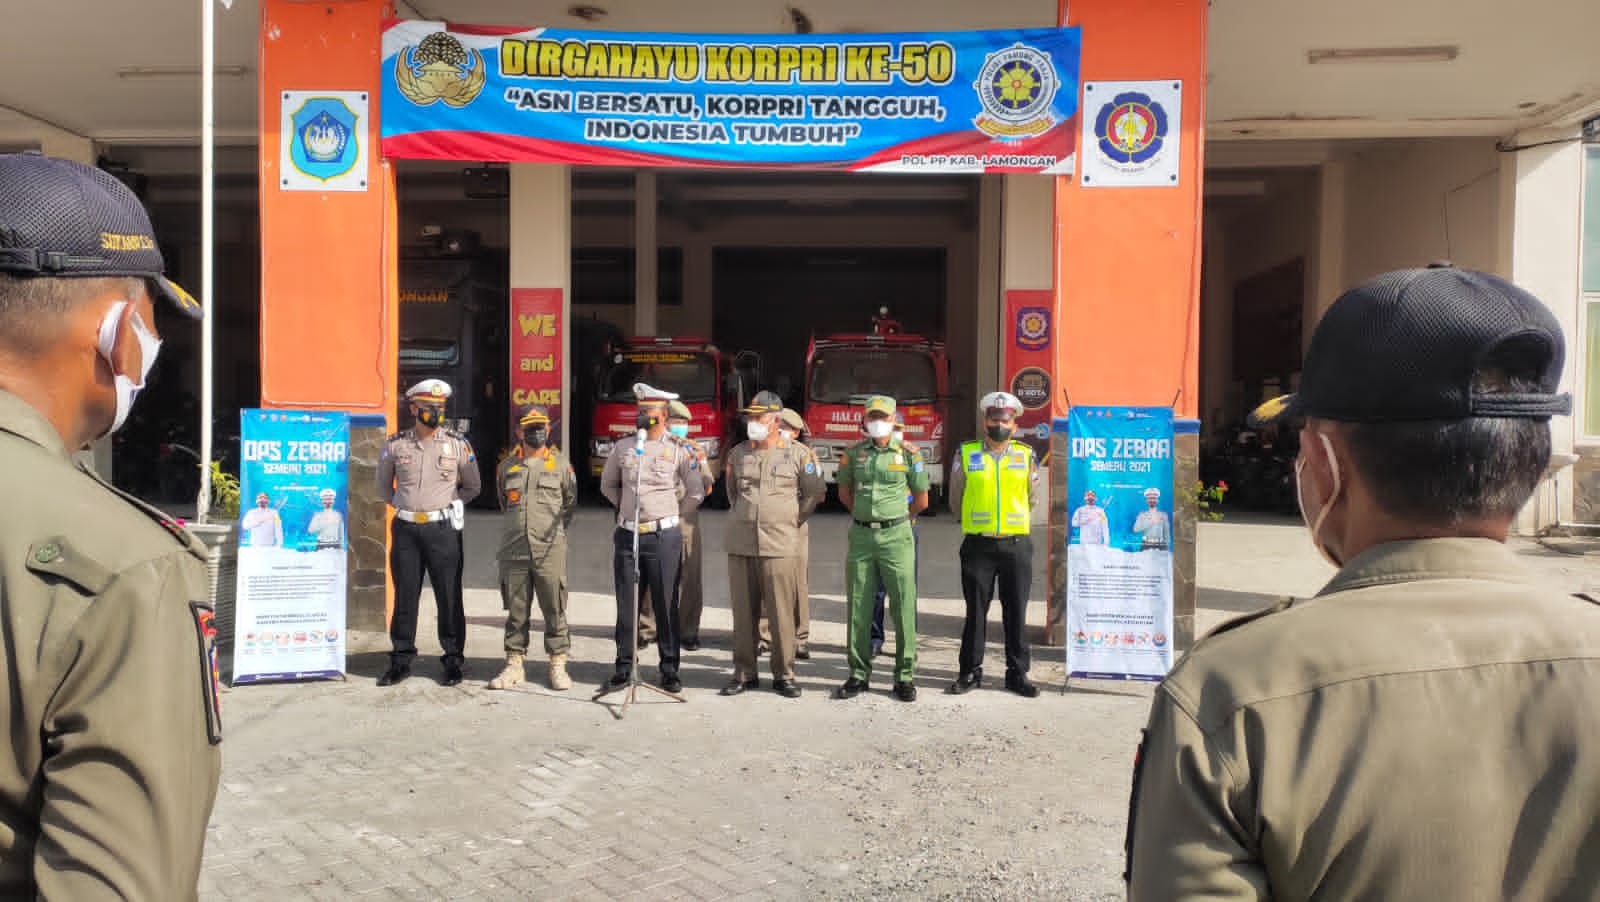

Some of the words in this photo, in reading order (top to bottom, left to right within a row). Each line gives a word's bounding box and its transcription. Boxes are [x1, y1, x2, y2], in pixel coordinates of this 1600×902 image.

[501, 39, 699, 81] DIRGAHAYU
[705, 43, 840, 83] KORPRI
[845, 42, 953, 84] KE-50
[578, 94, 700, 118] BERSATU,
[708, 96, 804, 117] KORPRI
[811, 97, 945, 121] TANGGUH,
[586, 120, 726, 142] INDONESIA
[902, 156, 926, 166] POL
[930, 156, 946, 166] PP
[950, 156, 978, 166] KAB.
[983, 156, 1055, 167] LAMONGAN
[518, 313, 556, 337] WE
[520, 353, 554, 372] and
[512, 388, 561, 406] CARE
[243, 439, 282, 461] OPS
[286, 440, 346, 462] ZEBRA
[1071, 437, 1107, 459] OPS
[1111, 438, 1172, 459] ZEBRA
